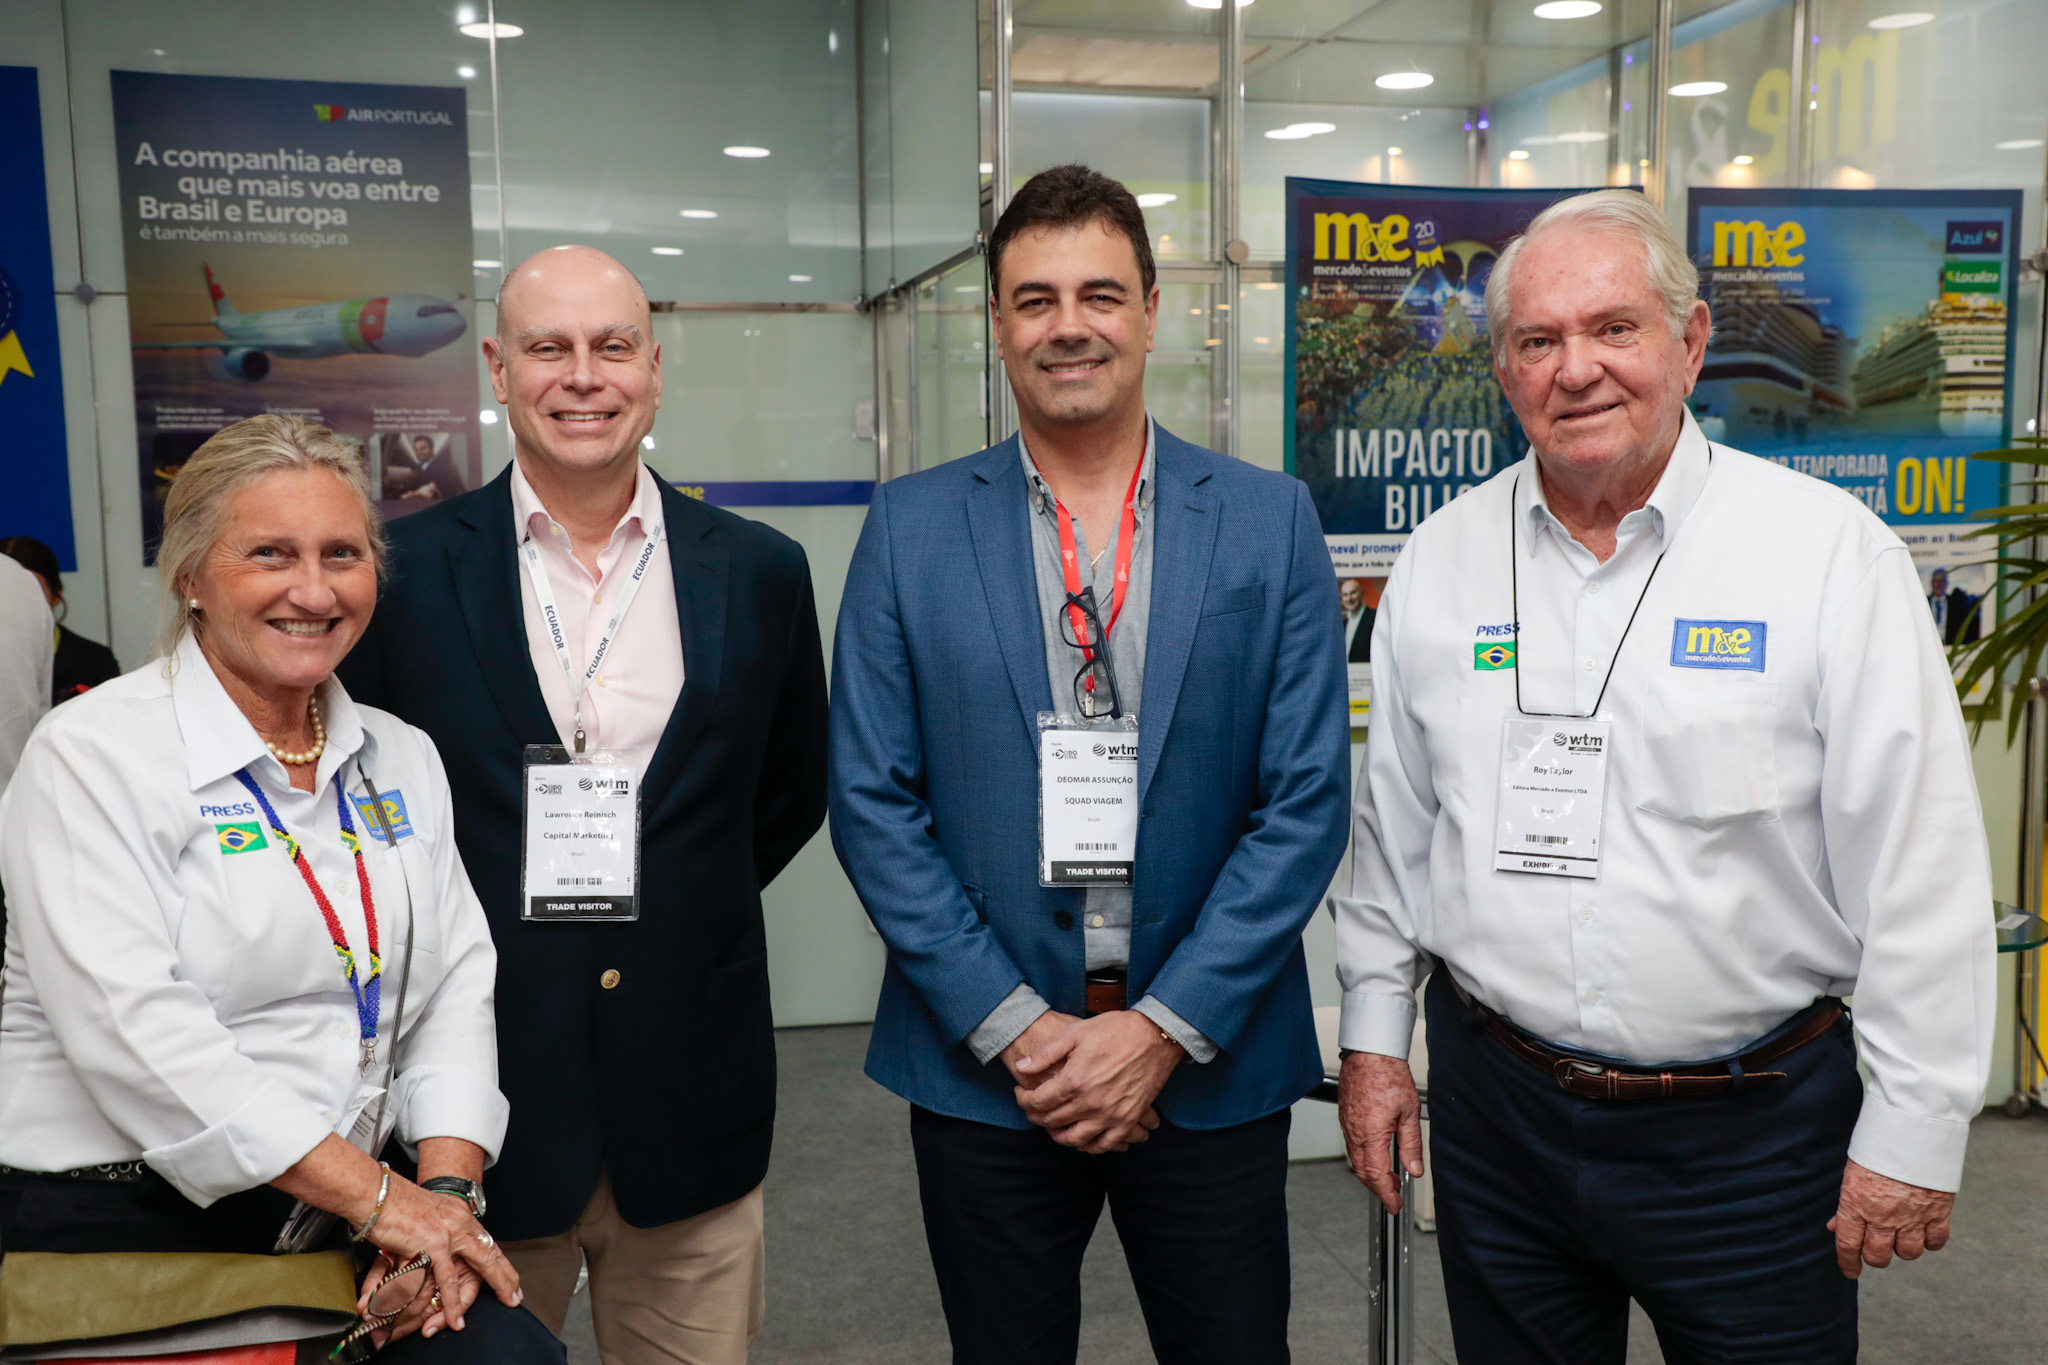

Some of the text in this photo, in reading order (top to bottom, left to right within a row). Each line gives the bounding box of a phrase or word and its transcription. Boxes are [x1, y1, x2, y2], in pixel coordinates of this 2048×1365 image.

[134, 141, 403, 176] A companhia aérea
[178, 174, 441, 203] que mais voa entre
[138, 195, 348, 230] Brasil e Europa
[139, 224, 349, 249] é também a mais segura
[1313, 211, 1412, 262] m&e
[1414, 220, 1435, 240] 20
[1951, 230, 1984, 246] Azul
[1713, 220, 1806, 268] m&e
[1955, 270, 2000, 284] Localiza
[1335, 428, 1493, 478] IMPACTO
[1792, 453, 1889, 478] TEMPORADA
[1895, 456, 1967, 516] ON!
[1385, 483, 1475, 531] BILI
[1328, 543, 1359, 554] naval
[633, 541, 656, 582] ECUADOR
[544, 604, 565, 651] ECUADOR
[1476, 621, 1521, 637] PRESS
[1685, 625, 1752, 655] m&e
[585, 636, 610, 680] ECUADOR
[1685, 653, 1752, 664] mercado&eventos
[1569, 733, 1603, 746] wtm
[1108, 743, 1138, 755] wtm
[1533, 766, 1548, 775] Roy
[595, 778, 629, 789] wtm
[1057, 775, 1134, 785] DEOMAR ASSUNÇÃO
[199, 801, 256, 818] PRESS
[1064, 797, 1123, 805] SQUAD VIAGEM
[543, 831, 572, 841] Capital
[1065, 867, 1128, 876] TRADE VISITOR
[1522, 860, 1568, 871] EXHIBIR
[546, 902, 613, 911] TRADE VISITOR
